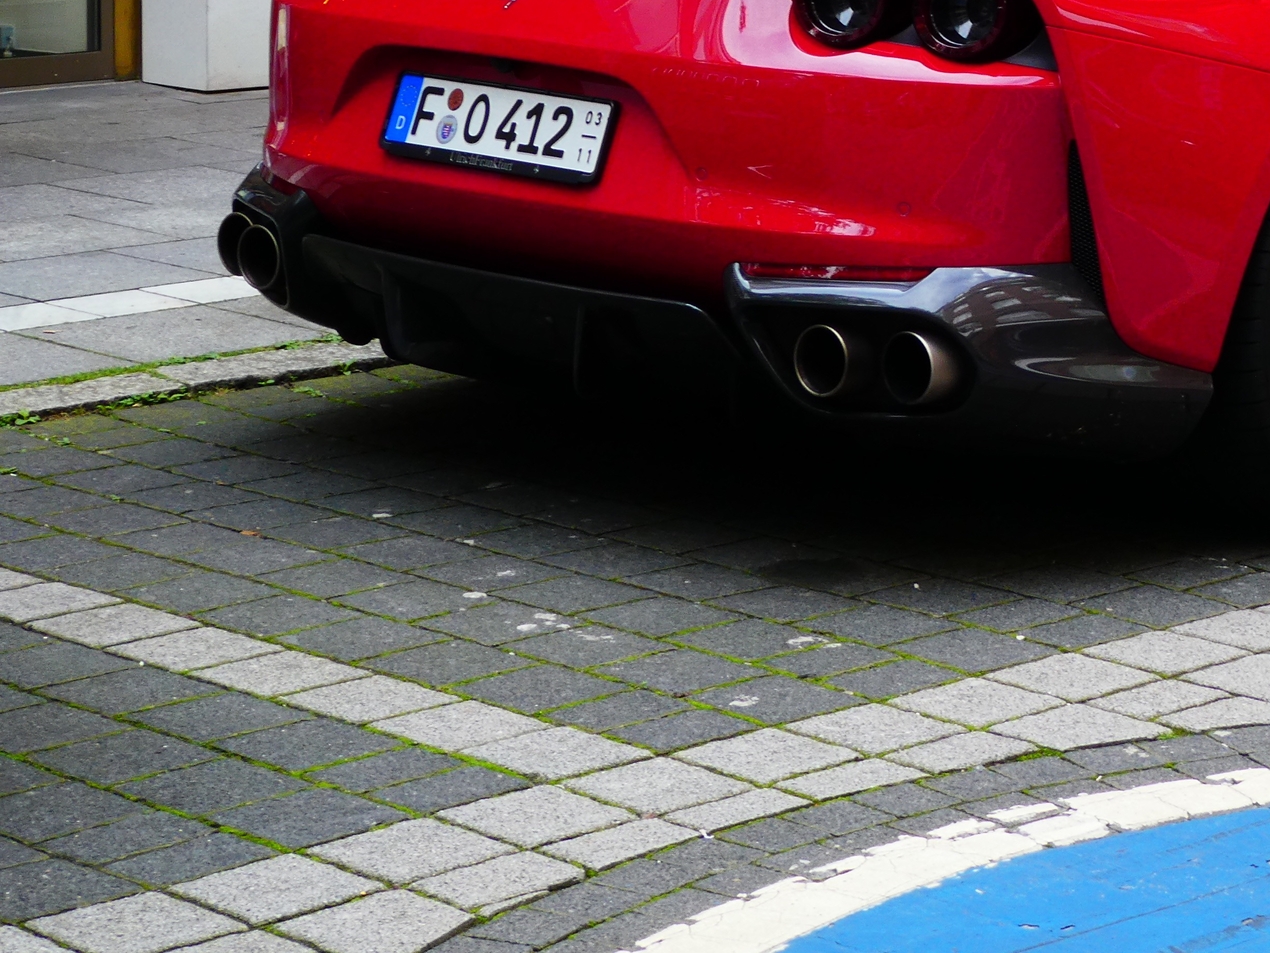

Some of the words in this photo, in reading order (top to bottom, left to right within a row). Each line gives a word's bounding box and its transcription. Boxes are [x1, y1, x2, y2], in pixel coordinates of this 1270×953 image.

[395, 115, 407, 130] D
[410, 85, 446, 136] F
[494, 98, 574, 159] 412
[584, 110, 603, 127] 03
[576, 147, 593, 164] 11
